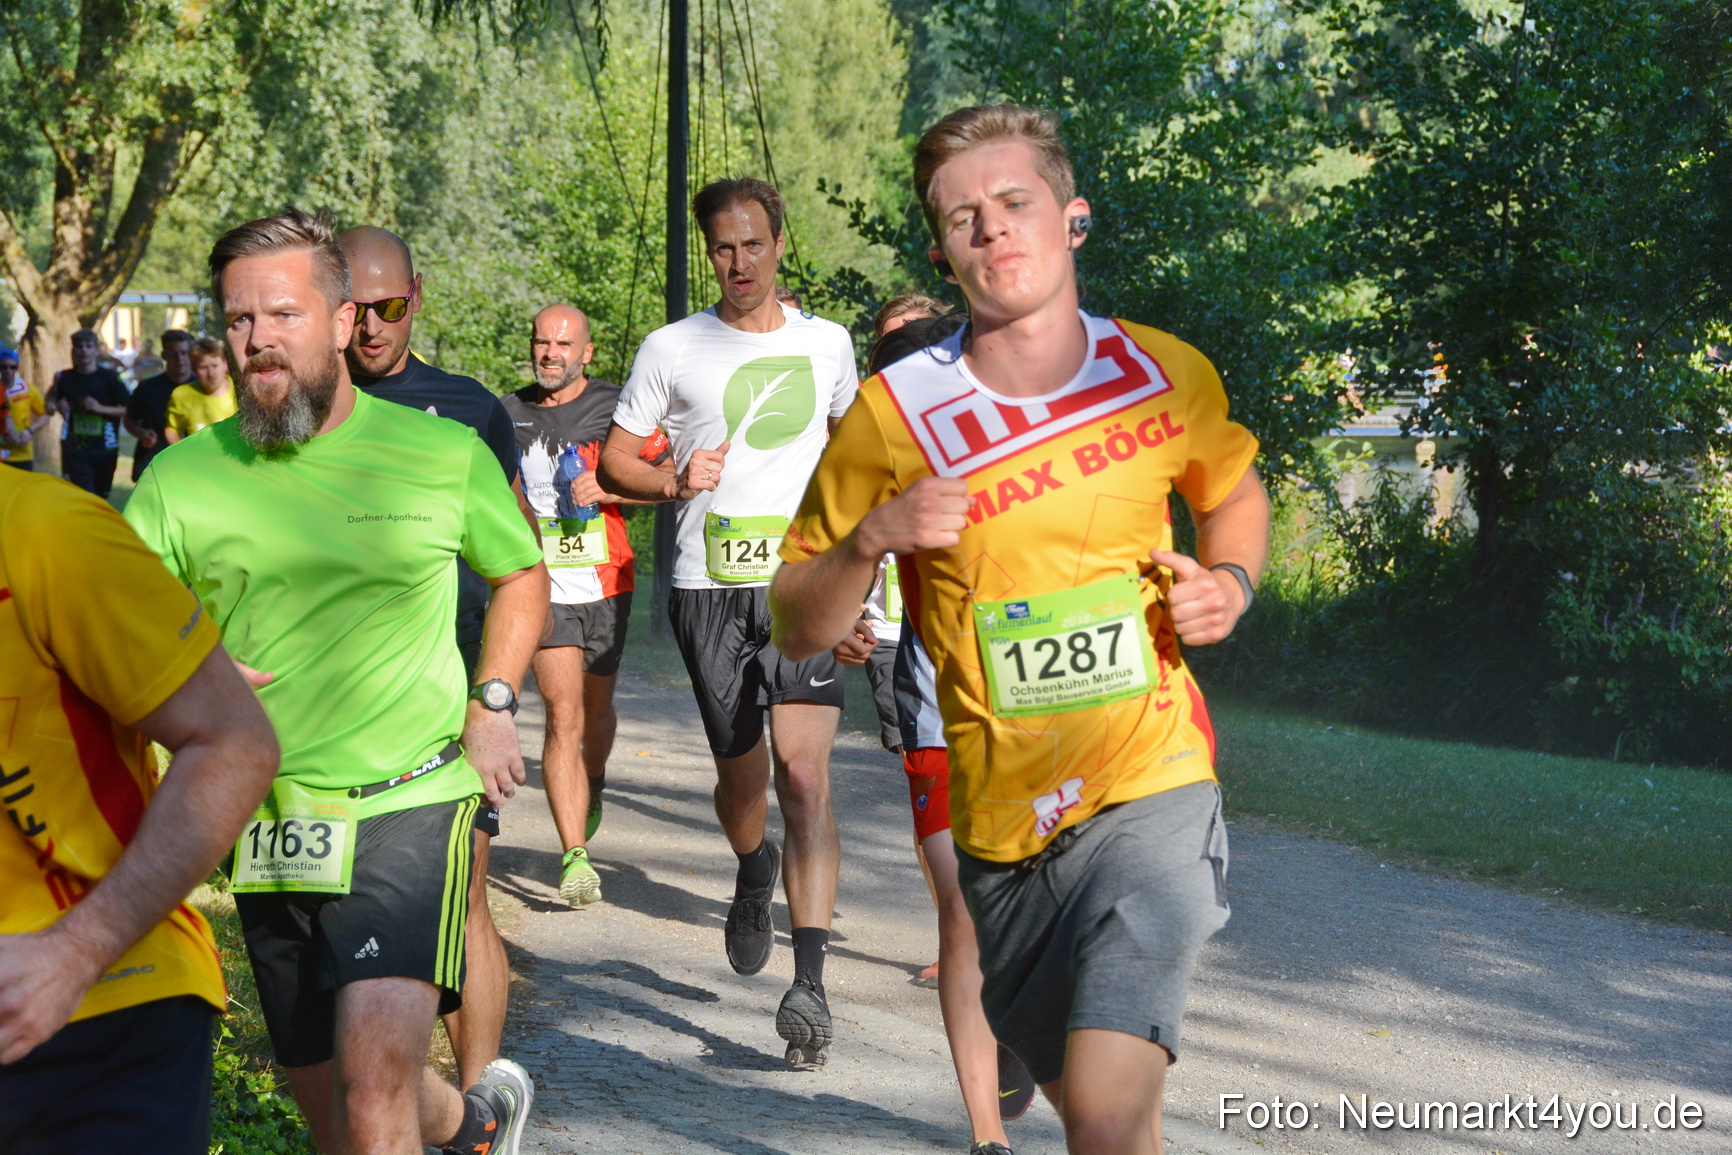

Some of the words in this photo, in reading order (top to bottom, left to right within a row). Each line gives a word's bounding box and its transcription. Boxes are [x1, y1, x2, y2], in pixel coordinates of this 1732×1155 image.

[963, 460, 1065, 530] MAX
[1072, 410, 1185, 478] BÖGL
[347, 512, 433, 524] Dorfner-Apotheken
[559, 536, 585, 554] 54
[721, 539, 770, 562] 124
[997, 611, 1053, 629] firmenlauf
[1004, 622, 1124, 682] 1287
[1010, 678, 1090, 697] Ochsenkühn
[1092, 668, 1134, 685] Marius
[1015, 697, 1033, 705] Max
[1035, 695, 1055, 706] Bögl
[1056, 687, 1104, 702] Bauservice
[1105, 680, 1132, 692] GmbH
[248, 820, 333, 860] 1163
[250, 861, 276, 871] Hiereth
[277, 861, 321, 871] Christian
